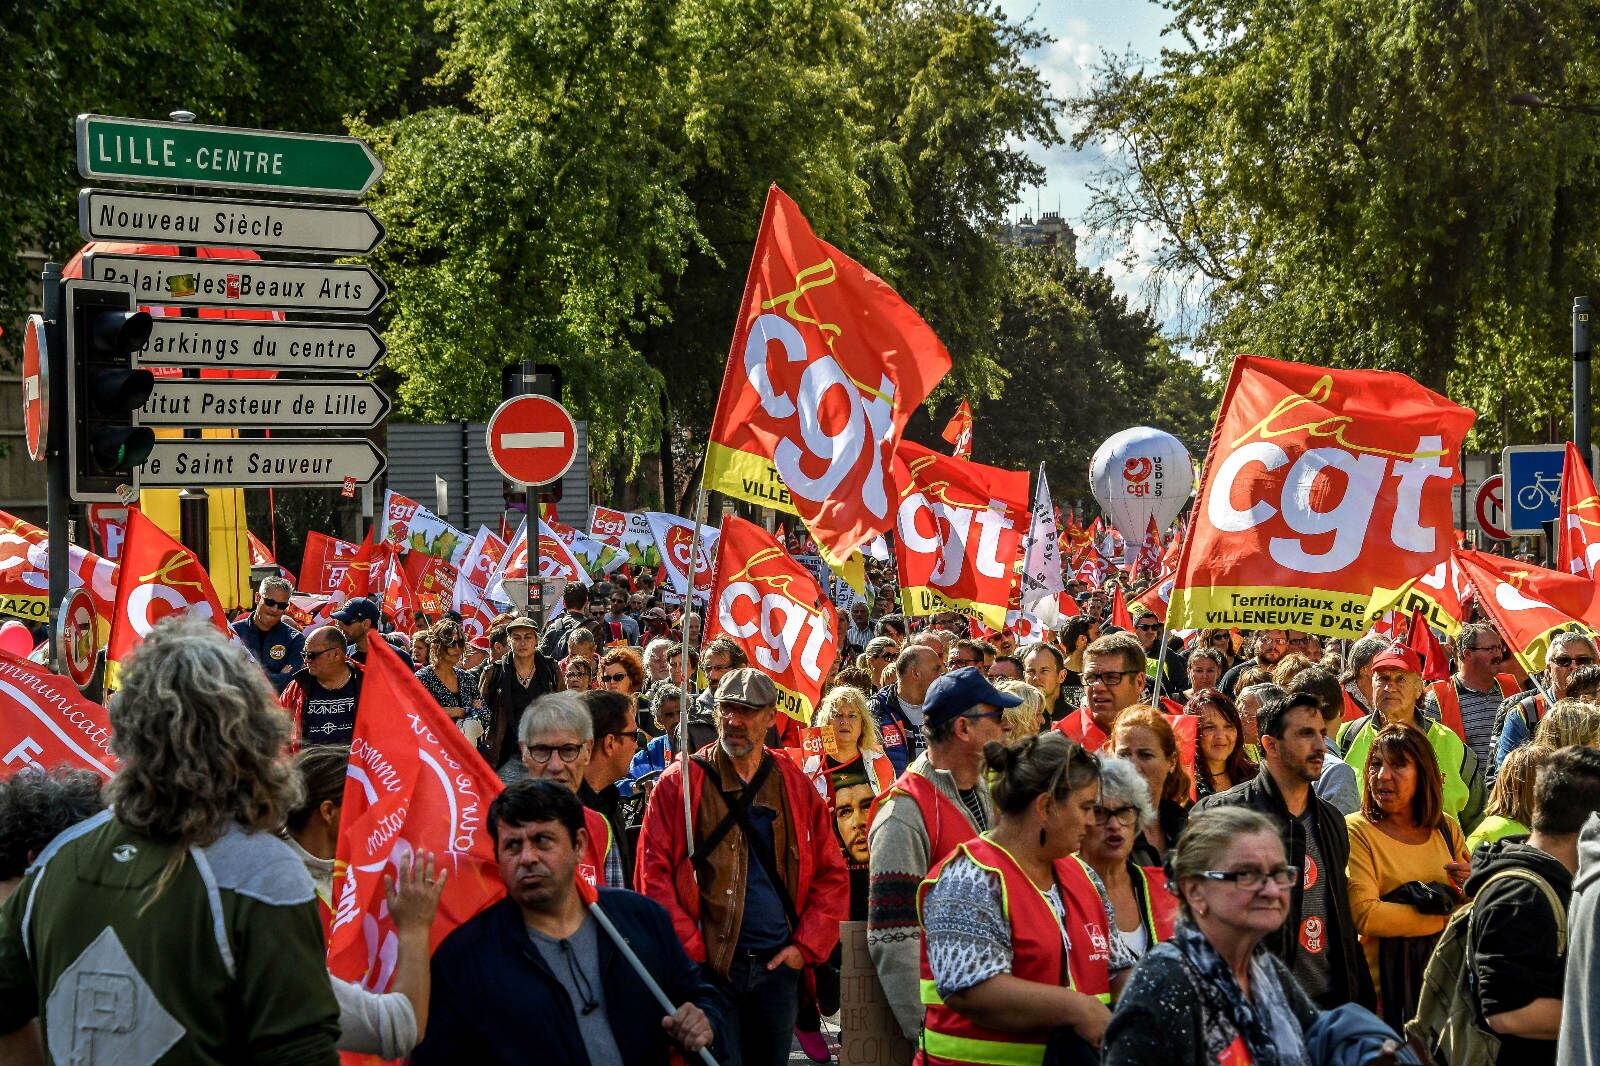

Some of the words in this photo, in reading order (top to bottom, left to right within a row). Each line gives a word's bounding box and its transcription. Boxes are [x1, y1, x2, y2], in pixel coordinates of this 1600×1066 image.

[99, 134, 176, 166] LILLE
[100, 204, 200, 233] Nouveau
[213, 211, 283, 237] Siècle
[240, 274, 304, 298] Beaux
[319, 278, 362, 300] Arts
[253, 335, 277, 357] du
[289, 341, 356, 359] centre
[141, 392, 190, 415] titut
[201, 393, 282, 416] Pasteur
[292, 394, 315, 416] de
[324, 394, 368, 416] Lille
[140, 459, 161, 475] re
[176, 453, 234, 475] Saint
[247, 453, 334, 475] Sauveur
[742, 478, 793, 505] VILLE
[1126, 481, 1151, 498] cgt
[389, 503, 415, 521] cgt
[1207, 435, 1453, 574] cgt
[595, 519, 626, 534] cgt
[631, 515, 647, 527] Ca
[897, 493, 1015, 587] cgt
[2, 599, 47, 617] AZO
[1231, 593, 1334, 611] Territoriaux
[1340, 600, 1365, 615] de
[718, 581, 835, 683] cgt
[1206, 610, 1314, 625] VILLENEUVE
[1319, 614, 1364, 632] D'AS
[803, 736, 823, 752] cgt
